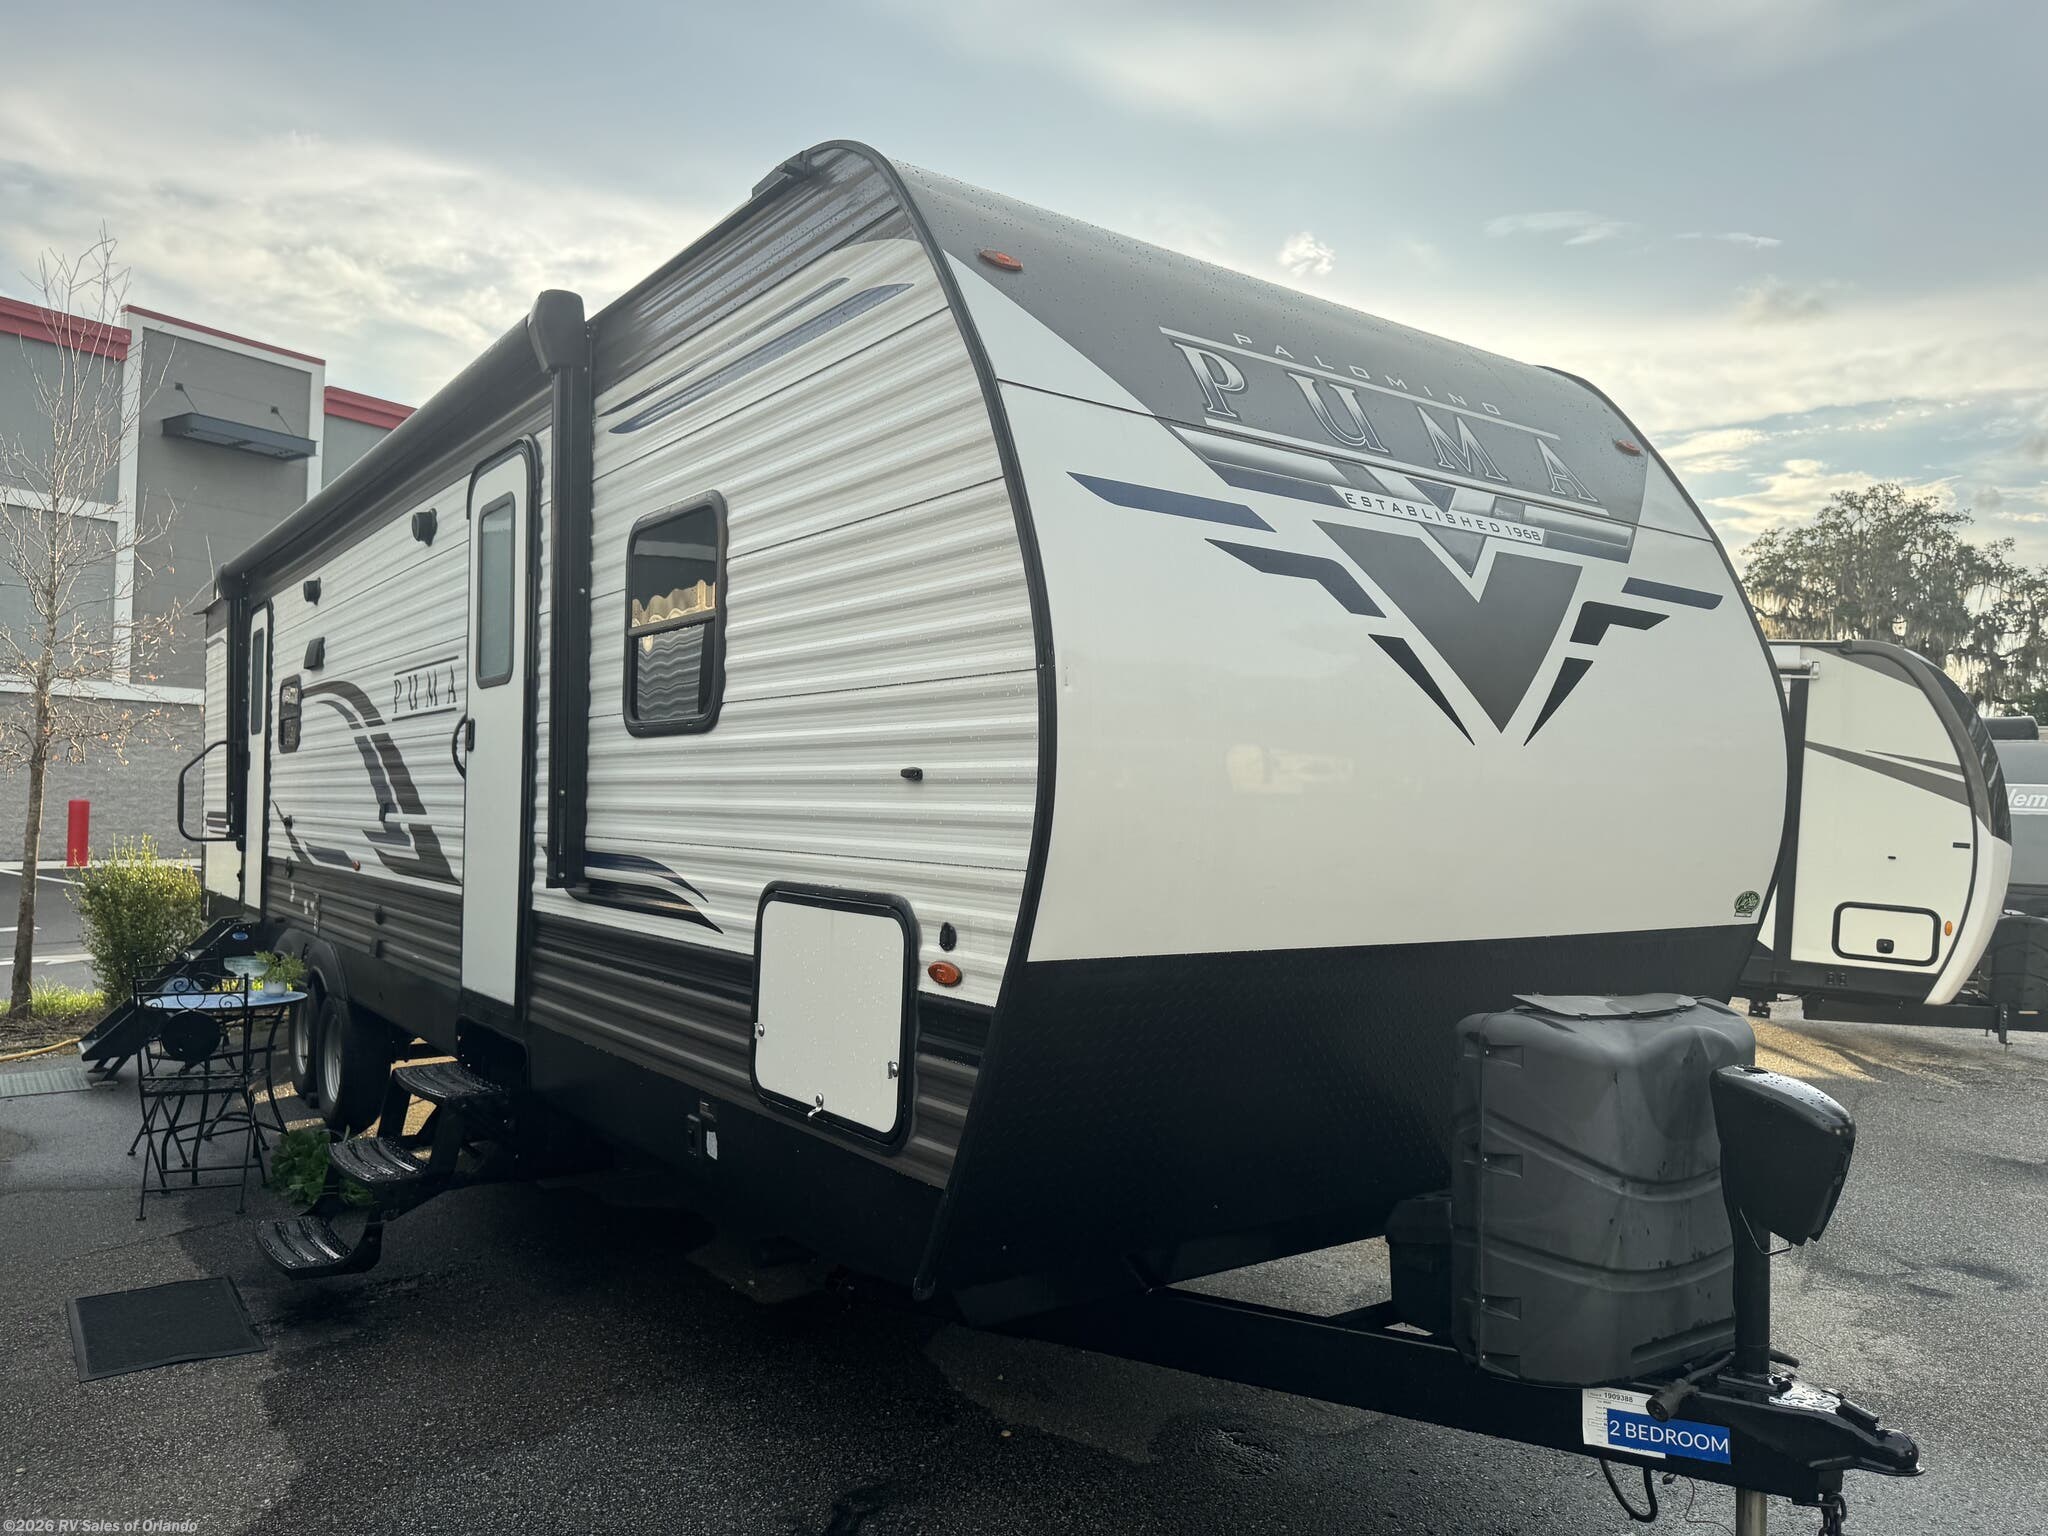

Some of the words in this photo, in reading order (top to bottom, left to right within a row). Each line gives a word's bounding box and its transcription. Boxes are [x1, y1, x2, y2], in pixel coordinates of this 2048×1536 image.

[1233, 332, 1501, 416] PALOMINO
[1172, 341, 1600, 503] PUMA
[1344, 492, 1501, 533] ESTABLISHED
[393, 664, 457, 714] PUMA
[1609, 1419, 1621, 1437] 2
[1625, 1422, 1729, 1454] BEDROOM
